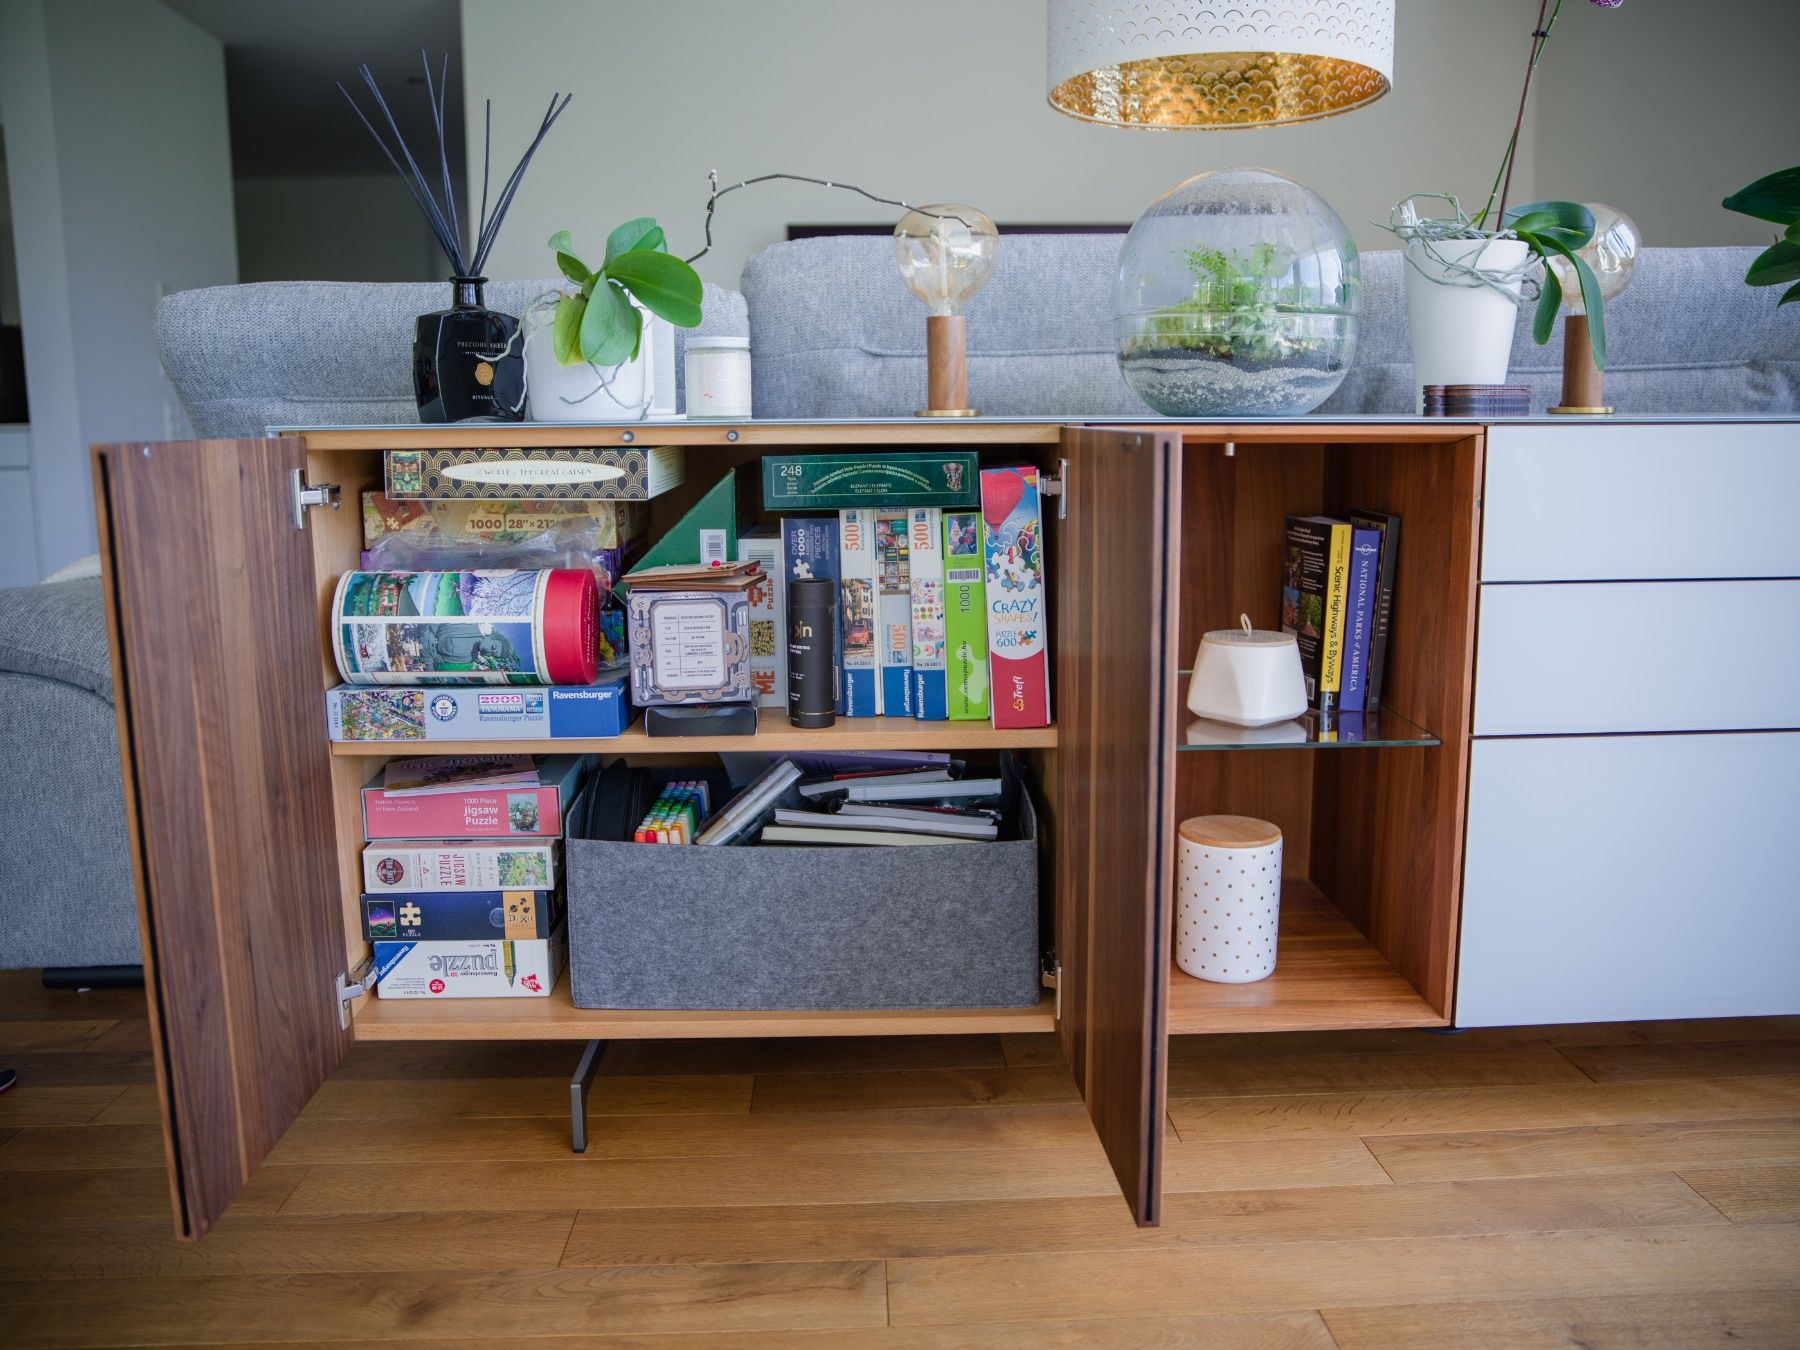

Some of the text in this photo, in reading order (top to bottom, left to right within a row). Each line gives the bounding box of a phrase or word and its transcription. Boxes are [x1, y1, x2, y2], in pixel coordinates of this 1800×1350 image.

[780, 465, 803, 477] 248
[469, 519, 502, 529] 1000
[844, 524, 860, 550] 500
[913, 523, 929, 550] 500
[797, 528, 806, 557] 1000
[814, 526, 822, 559] PIECES
[766, 579, 774, 610] Puzzle
[1357, 560, 1369, 609] NATIONAL
[959, 585, 970, 613] 1000
[992, 598, 1038, 615] CRAZY
[892, 623, 907, 650] 500
[995, 630, 1017, 638] PUZZLE
[1325, 566, 1344, 684] Scenic Highways & Byways
[1354, 611, 1364, 640] PARKS
[996, 638, 1017, 648] 600
[1349, 649, 1361, 692] AMERICA
[481, 695, 521, 704] 2000
[552, 691, 612, 700] Ravensburger
[846, 673, 855, 717] Ravensburger
[917, 673, 925, 719] Ravensburger
[1013, 676, 1025, 699] Trefl
[479, 714, 522, 722] Ravensburger
[463, 806, 498, 816] Jigsaw
[465, 816, 499, 825] Puzzle
[438, 854, 452, 886] PUZZLE
[452, 854, 466, 886] JIGSAW
[379, 944, 409, 977] Ravensburger
